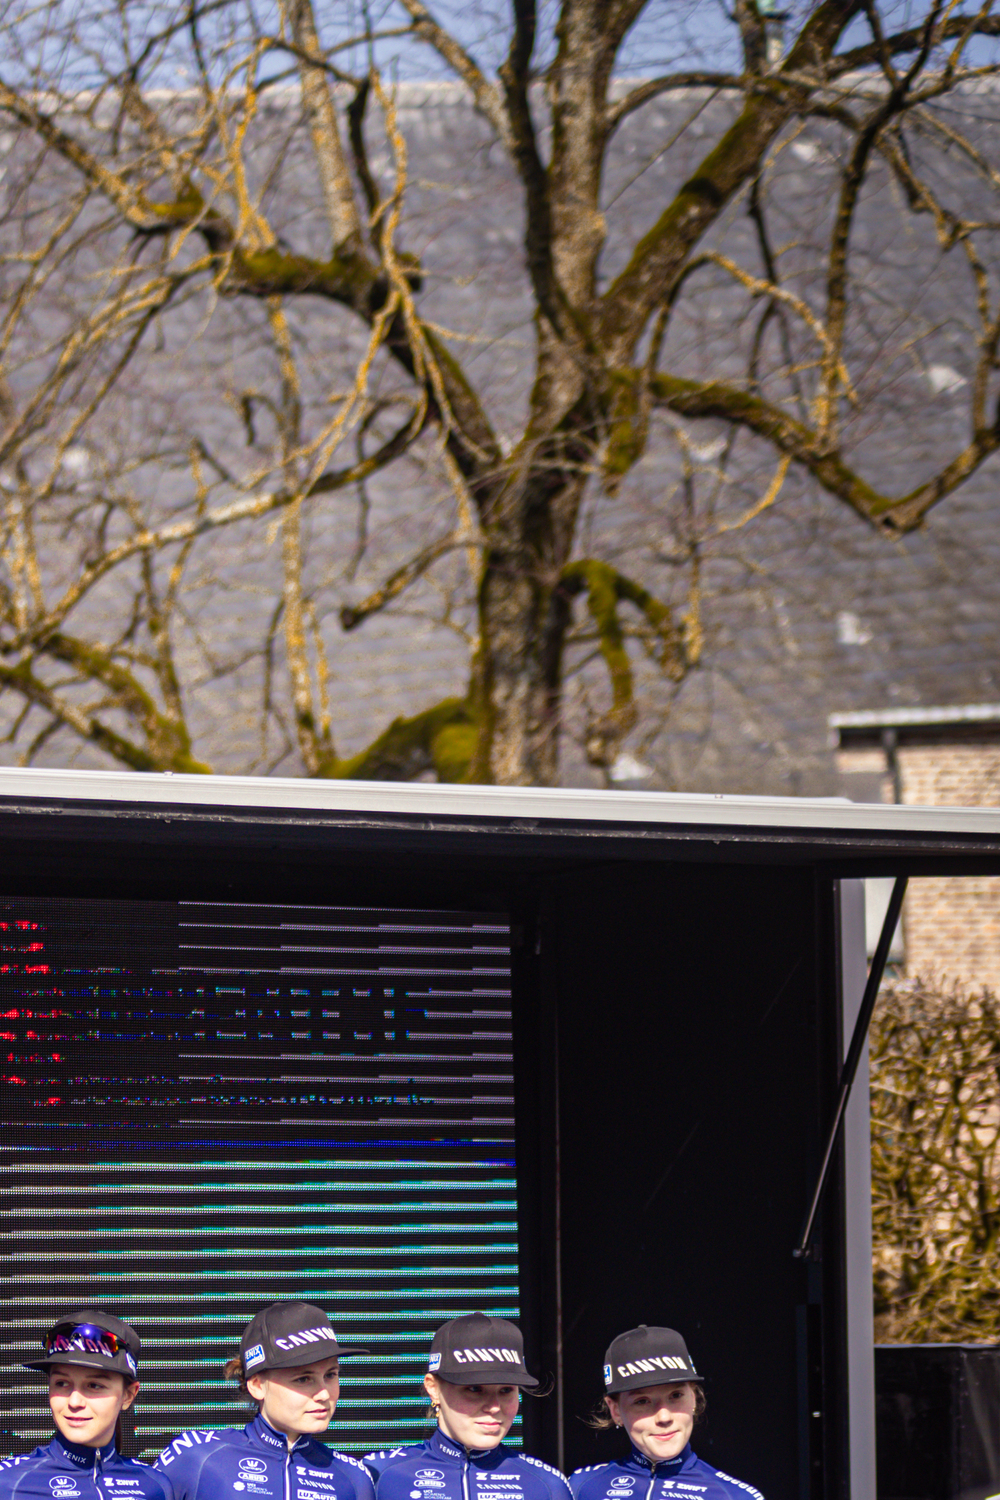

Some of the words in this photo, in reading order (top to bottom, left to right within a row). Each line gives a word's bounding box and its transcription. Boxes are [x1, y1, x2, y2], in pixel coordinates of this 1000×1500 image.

[453, 1348, 521, 1365] CANYON
[617, 1356, 688, 1377] CANYON
[260, 1432, 284, 1448] FENIX
[62, 1450, 87, 1464] FENIX
[439, 1444, 462, 1458] FENIX
[676, 1483, 708, 1492] ZWIFT
